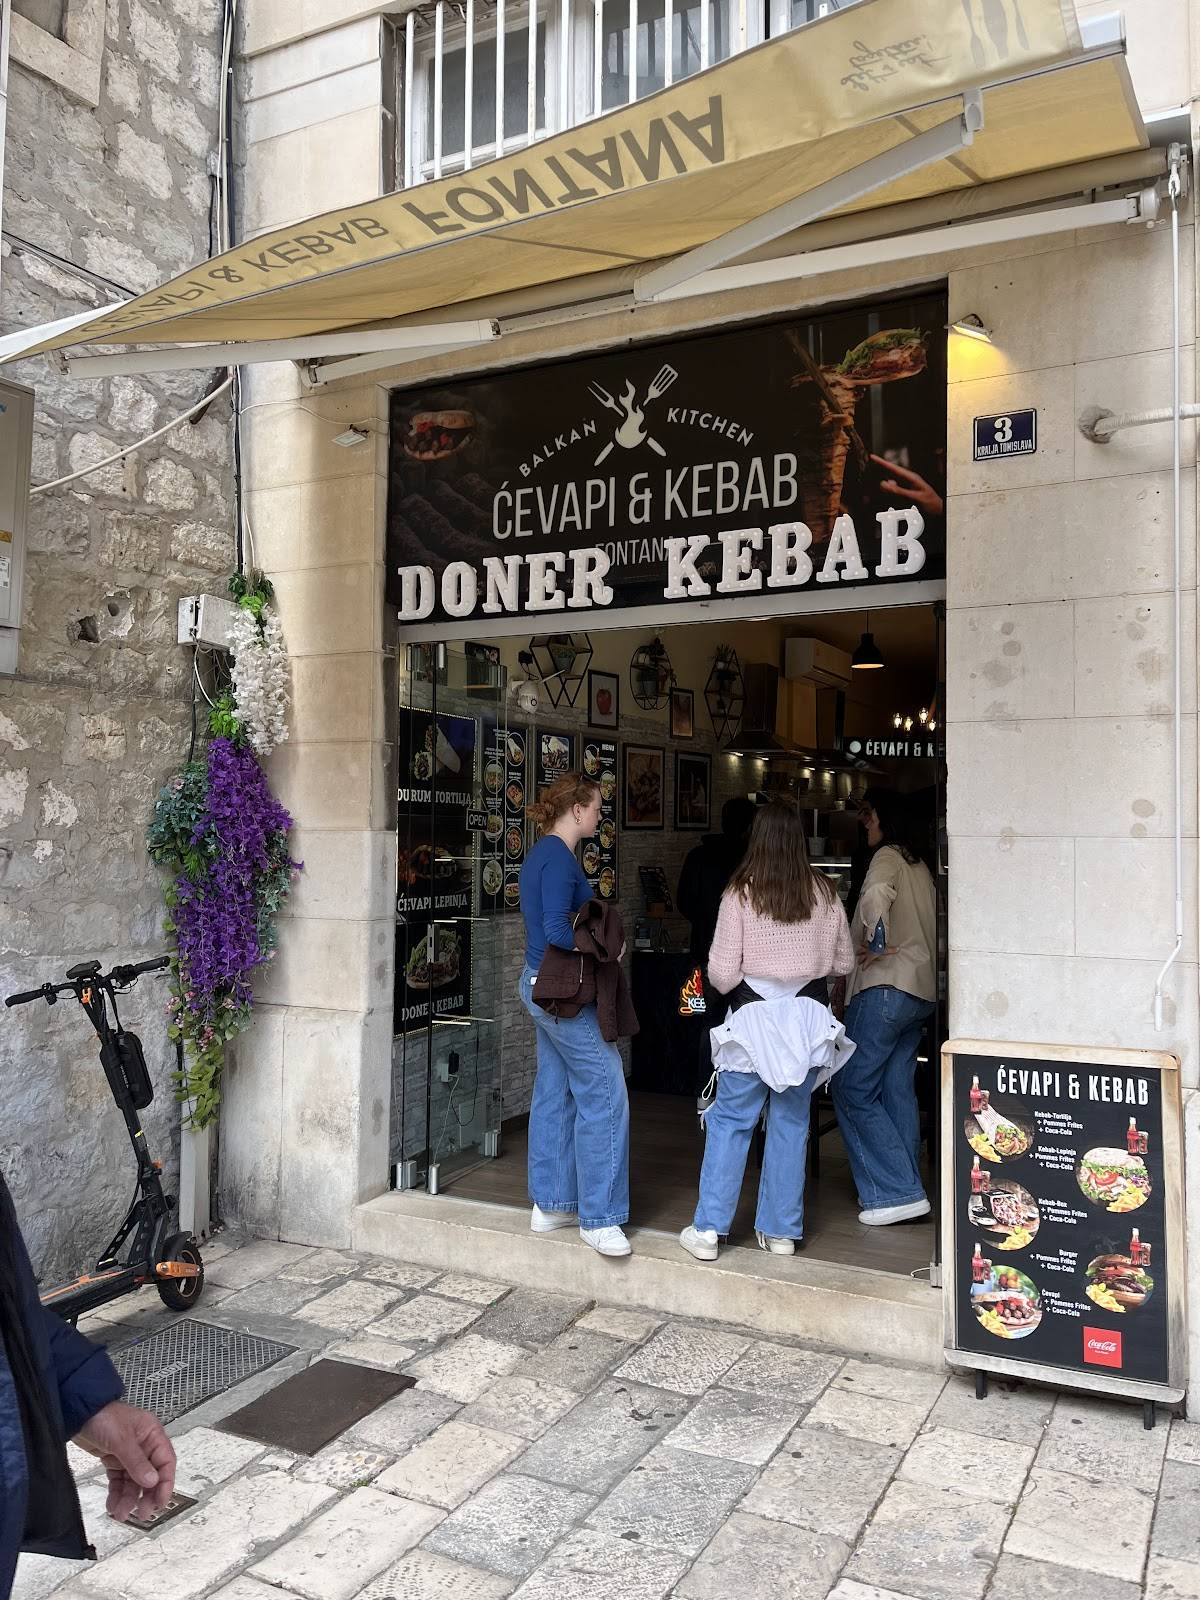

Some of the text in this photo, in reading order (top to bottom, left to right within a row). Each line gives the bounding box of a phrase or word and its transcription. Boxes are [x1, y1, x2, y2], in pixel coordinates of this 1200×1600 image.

[993, 416, 1013, 443] 3
[518, 406, 755, 478] BALKAN KITCHEN
[977, 439, 1033, 457] KRALJA TOMISLAVA
[492, 452, 799, 540] ĆEVAPI & KEBAB
[397, 505, 927, 621] DONER KEBAB
[866, 739, 909, 757] ĆEVAPI
[913, 742, 922, 757] &
[468, 813, 487, 827] OPEN
[434, 893, 468, 909] LEPINJA
[436, 993, 464, 1014] KEBAB
[997, 1064, 1149, 1106] ĆEVAPI & KEBAB
[1043, 1119, 1067, 1128] Pommes
[1067, 1121, 1083, 1130] Frites
[1044, 1126, 1073, 1136] Coca-Cola
[1034, 1152, 1058, 1162] Pommes
[1059, 1155, 1075, 1163] Frites
[1045, 1161, 1074, 1171] Coca-Cola
[1047, 1206, 1071, 1216] Pommes
[1071, 1209, 1088, 1218] Frites
[1048, 1214, 1077, 1225] Coca-Cola
[1035, 1253, 1060, 1263] Pommes
[1060, 1256, 1077, 1266] Frites
[1058, 1248, 1079, 1259] Burger
[1046, 1262, 1075, 1273] Coca-Cola
[1050, 1298, 1075, 1309] Pommes
[1074, 1301, 1091, 1312] Frites
[1052, 1306, 1081, 1317] Coca-Cola
